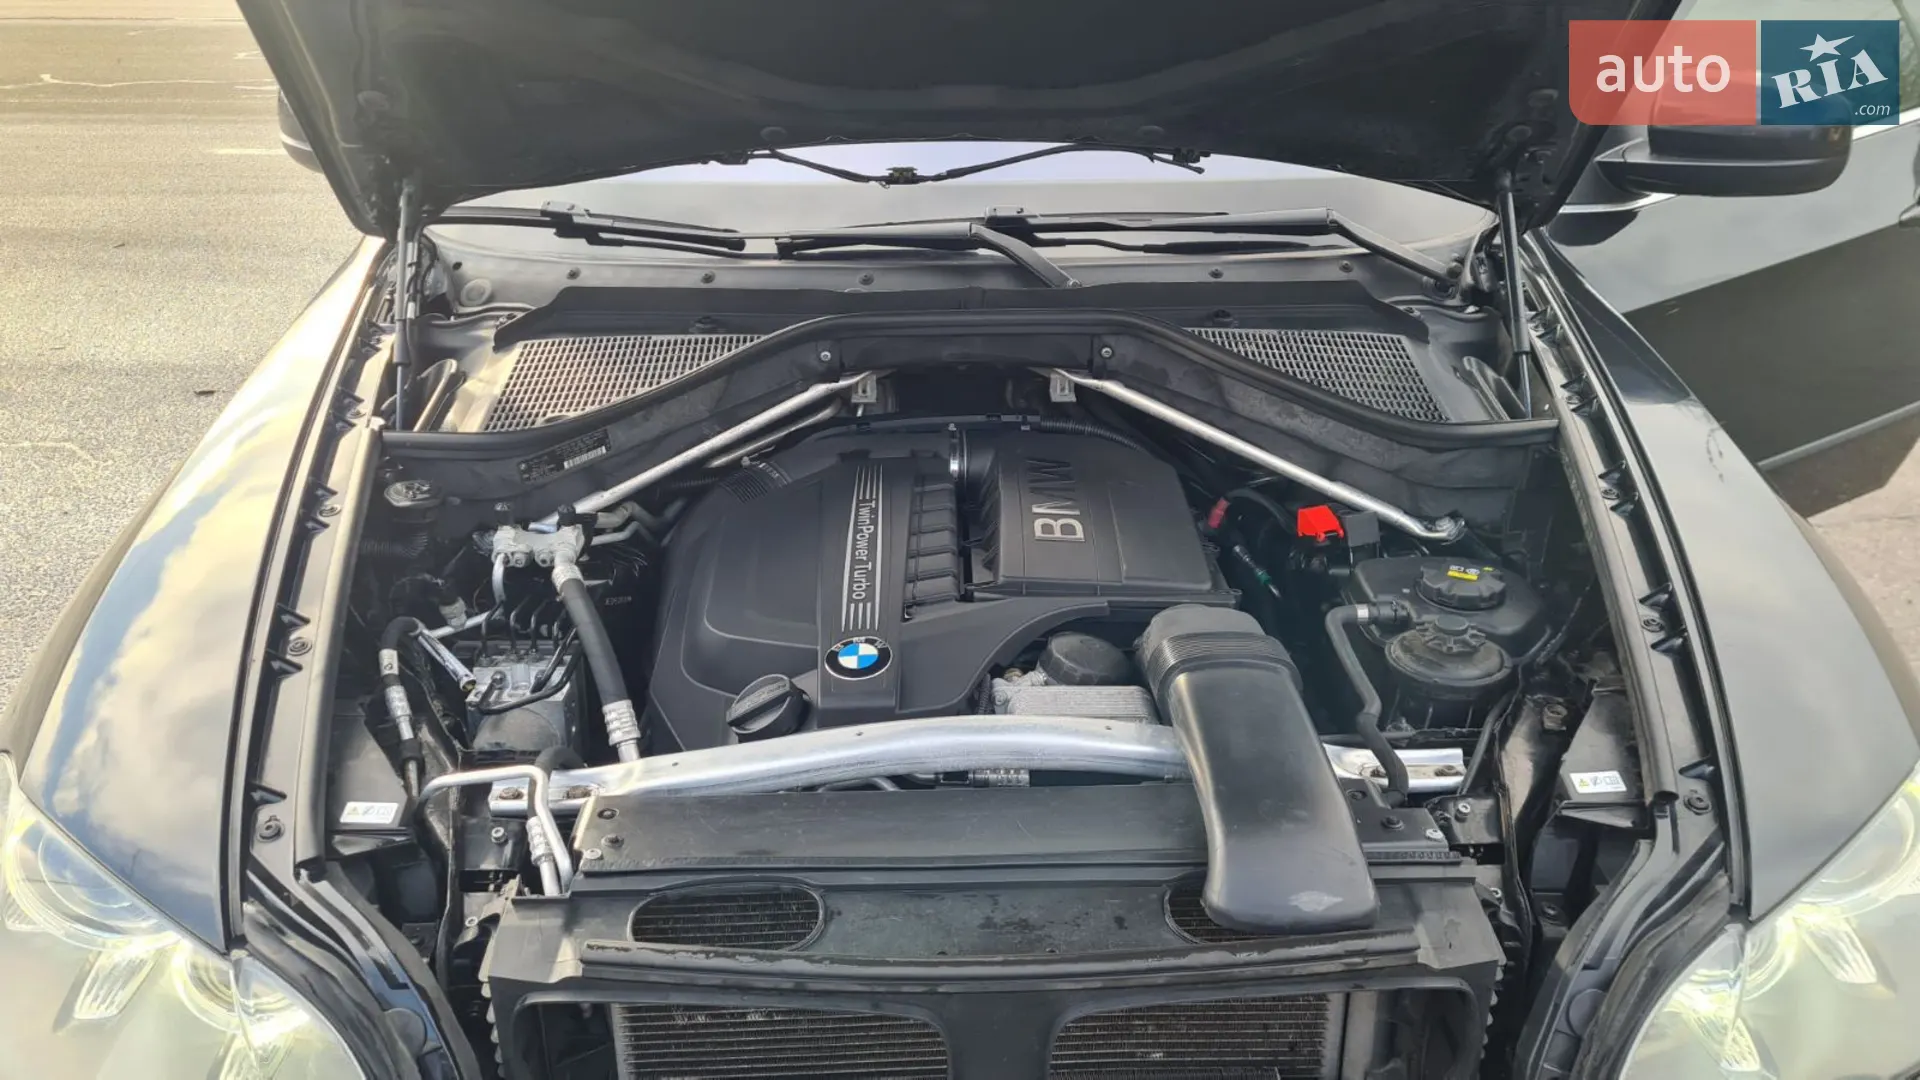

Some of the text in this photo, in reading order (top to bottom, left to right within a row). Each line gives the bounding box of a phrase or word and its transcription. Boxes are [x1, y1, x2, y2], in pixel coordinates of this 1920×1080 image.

[1025, 458, 1085, 541] BMW
[852, 500, 876, 600] TwinPower Turbo
